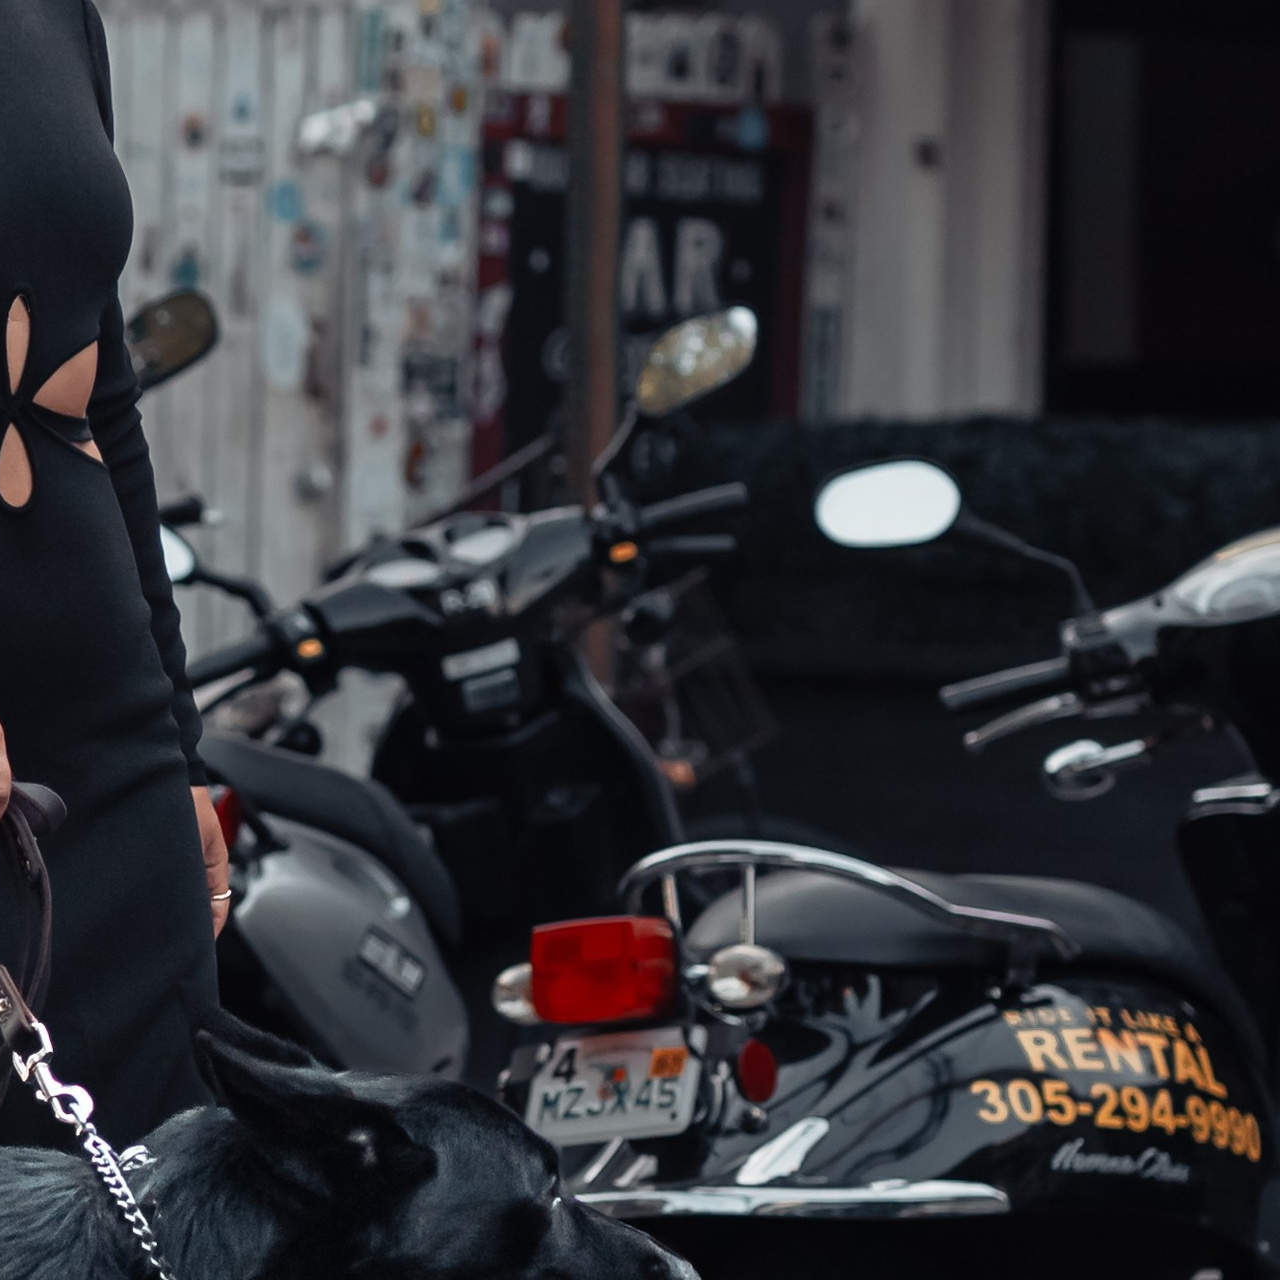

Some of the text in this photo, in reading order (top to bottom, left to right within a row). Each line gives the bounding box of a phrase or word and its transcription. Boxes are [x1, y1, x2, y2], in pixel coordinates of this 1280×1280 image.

[618, 214, 724, 317] AR
[552, 1047, 578, 1084] 4
[1016, 1027, 1228, 1099] RENTAL
